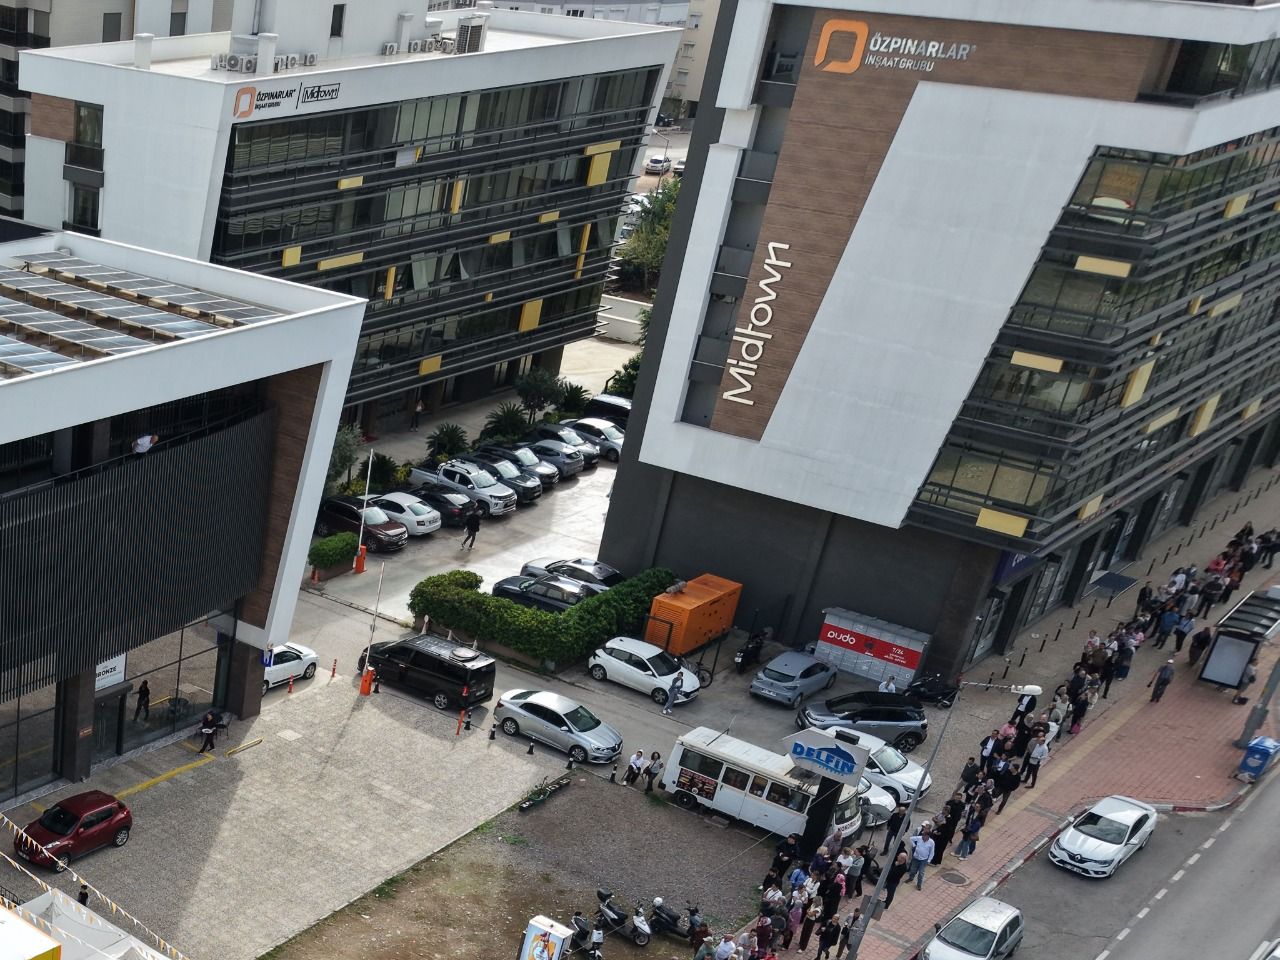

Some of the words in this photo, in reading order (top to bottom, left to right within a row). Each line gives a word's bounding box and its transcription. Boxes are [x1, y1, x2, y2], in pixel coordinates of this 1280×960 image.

[870, 32, 971, 60] ÖZPINARLAR
[304, 85, 338, 101] Midtown
[722, 241, 792, 406] Midtown
